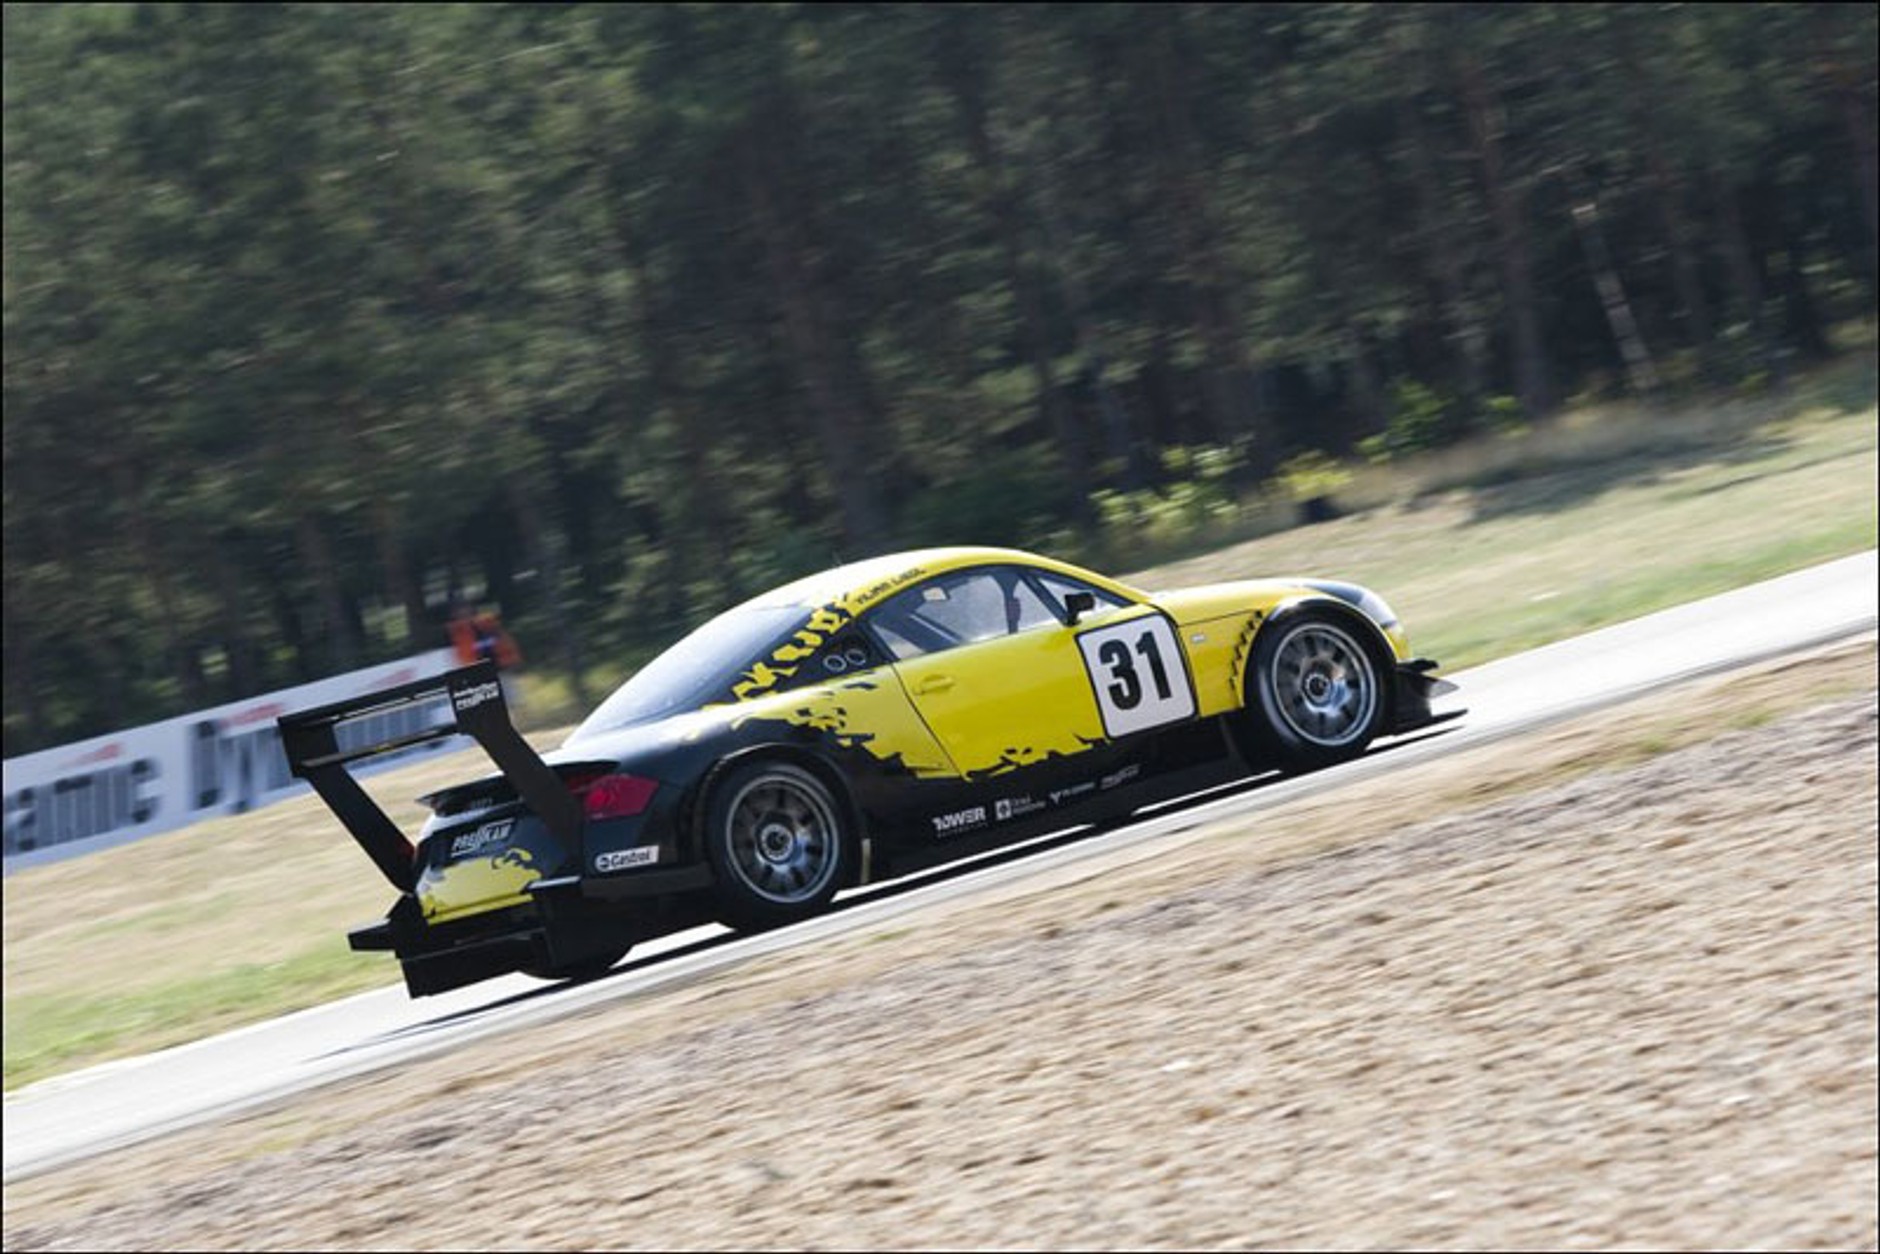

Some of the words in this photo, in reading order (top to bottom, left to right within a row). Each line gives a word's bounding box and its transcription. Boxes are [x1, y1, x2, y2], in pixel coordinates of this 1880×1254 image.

[1099, 631, 1172, 710] 31
[932, 806, 986, 831] TOWER
[610, 850, 651, 868] Castrol
